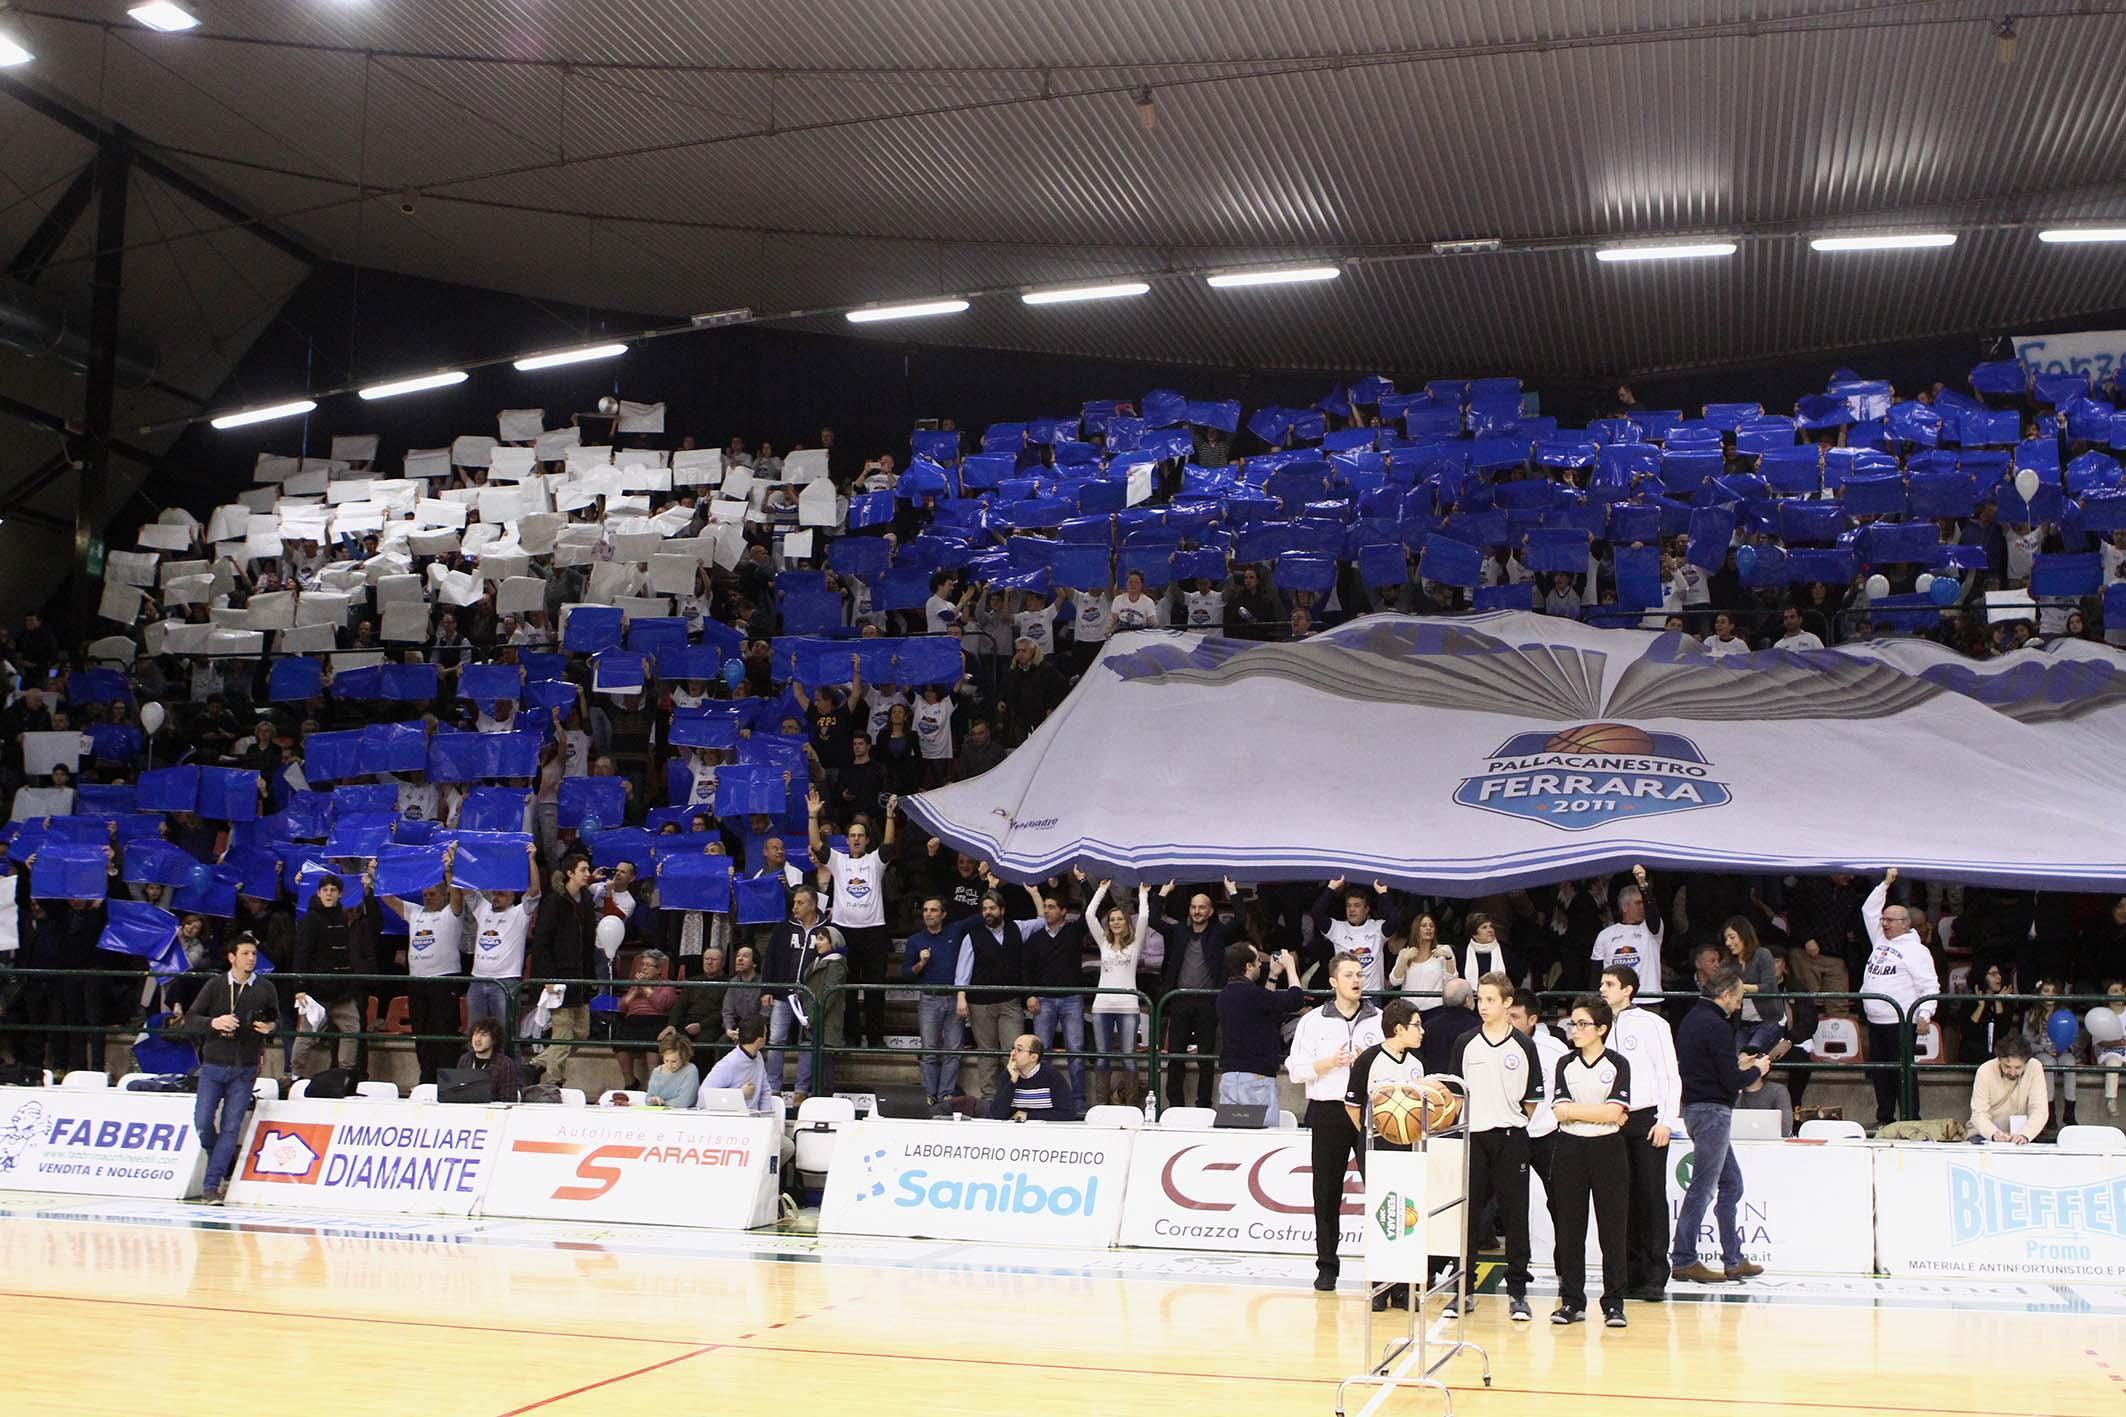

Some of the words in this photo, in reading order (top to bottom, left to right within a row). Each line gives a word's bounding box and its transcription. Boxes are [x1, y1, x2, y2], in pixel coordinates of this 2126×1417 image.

[2017, 341, 2126, 384] Forz
[1488, 755, 1708, 778] PALLACANESTRO
[1478, 773, 1704, 804] FERRARA
[1551, 798, 1617, 814] 2011
[47, 1117, 190, 1152] FABBRI
[337, 1124, 489, 1150] IMMOBILIARE
[558, 1125, 646, 1141] Autolinee
[656, 1133, 665, 1142] e
[676, 1130, 750, 1146] Turismo
[904, 1143, 1005, 1162] LABORATORIO
[1010, 1148, 1105, 1165] ORTOPEDICO
[38, 1162, 91, 1176] VENDITA
[95, 1165, 104, 1176] E
[107, 1166, 174, 1181] NOLEGGIO
[324, 1153, 481, 1193] DIAMANTE
[893, 1169, 1099, 1217] Sanibol
[1154, 1218, 1239, 1239] Corazza
[2026, 1239, 2091, 1261] Promo
[1908, 1259, 1976, 1273] MATERIALE
[1978, 1262, 2104, 1276] ANTINFORTUNISTICO
[2107, 1265, 2115, 1276] E
